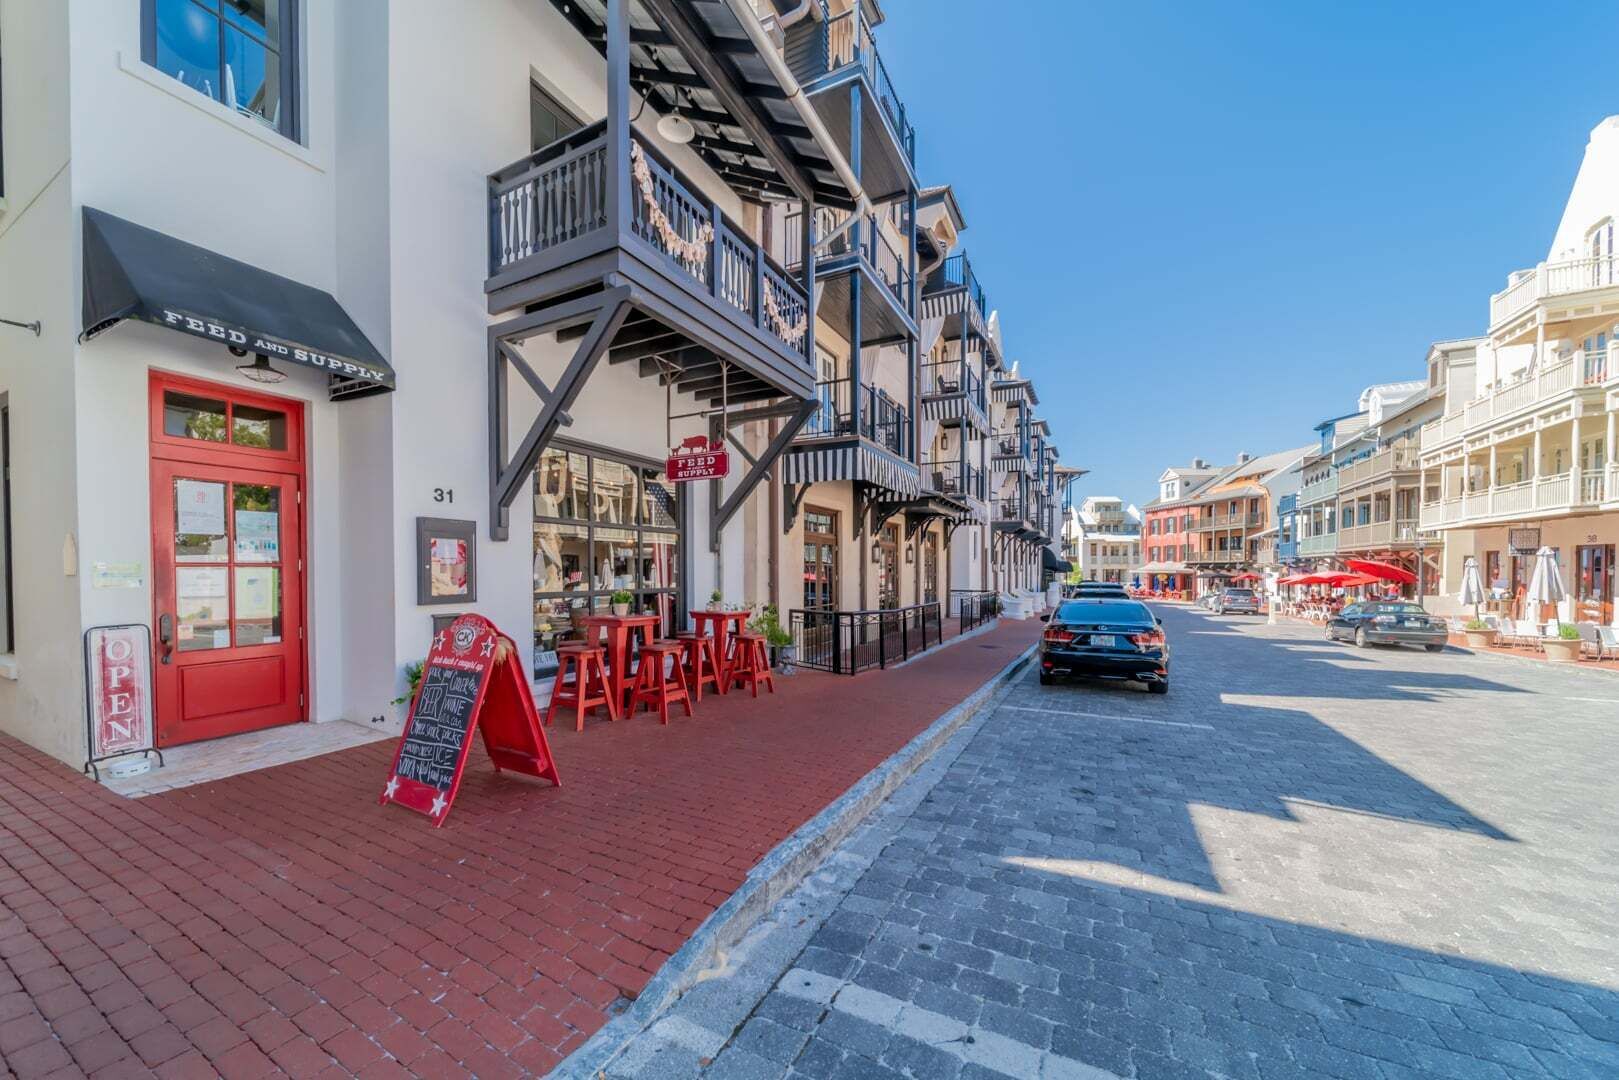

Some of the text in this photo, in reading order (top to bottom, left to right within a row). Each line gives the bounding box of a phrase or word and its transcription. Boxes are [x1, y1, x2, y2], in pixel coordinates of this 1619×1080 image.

[164, 310, 384, 382] FEED AND SUPPLY
[677, 457, 716, 468] FEED
[677, 468, 714, 478] SUPPLY
[433, 488, 453, 503] 31
[107, 639, 132, 741] OPEN
[419, 686, 443, 717] BEER
